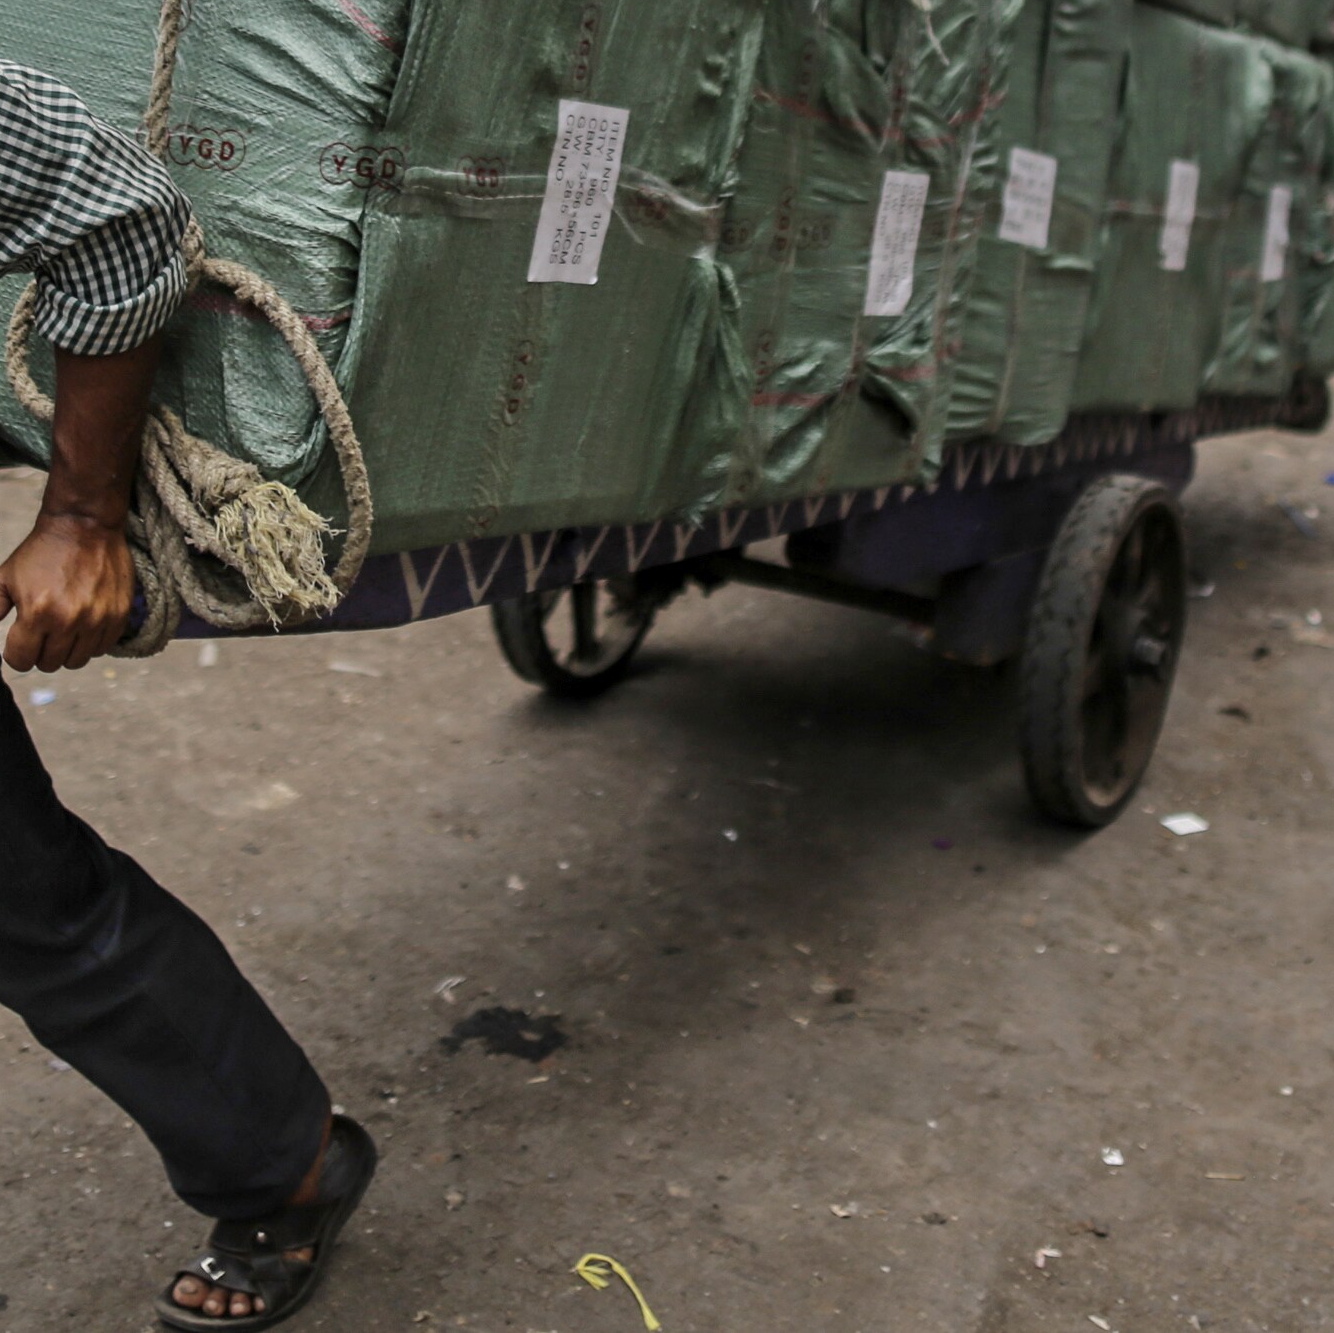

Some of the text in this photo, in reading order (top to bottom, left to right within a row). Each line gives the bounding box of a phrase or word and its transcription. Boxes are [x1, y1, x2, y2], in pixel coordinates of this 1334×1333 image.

[562, 115, 575, 150] CTN
[605, 121, 619, 162] ITEM
[178, 135, 236, 162] YGD
[331, 154, 397, 179] YGD
[463, 166, 500, 188] YGD
[584, 177, 598, 207] 960
[589, 212, 603, 239] 101
[548, 227, 563, 265] KGS
[571, 230, 586, 266] PCS
